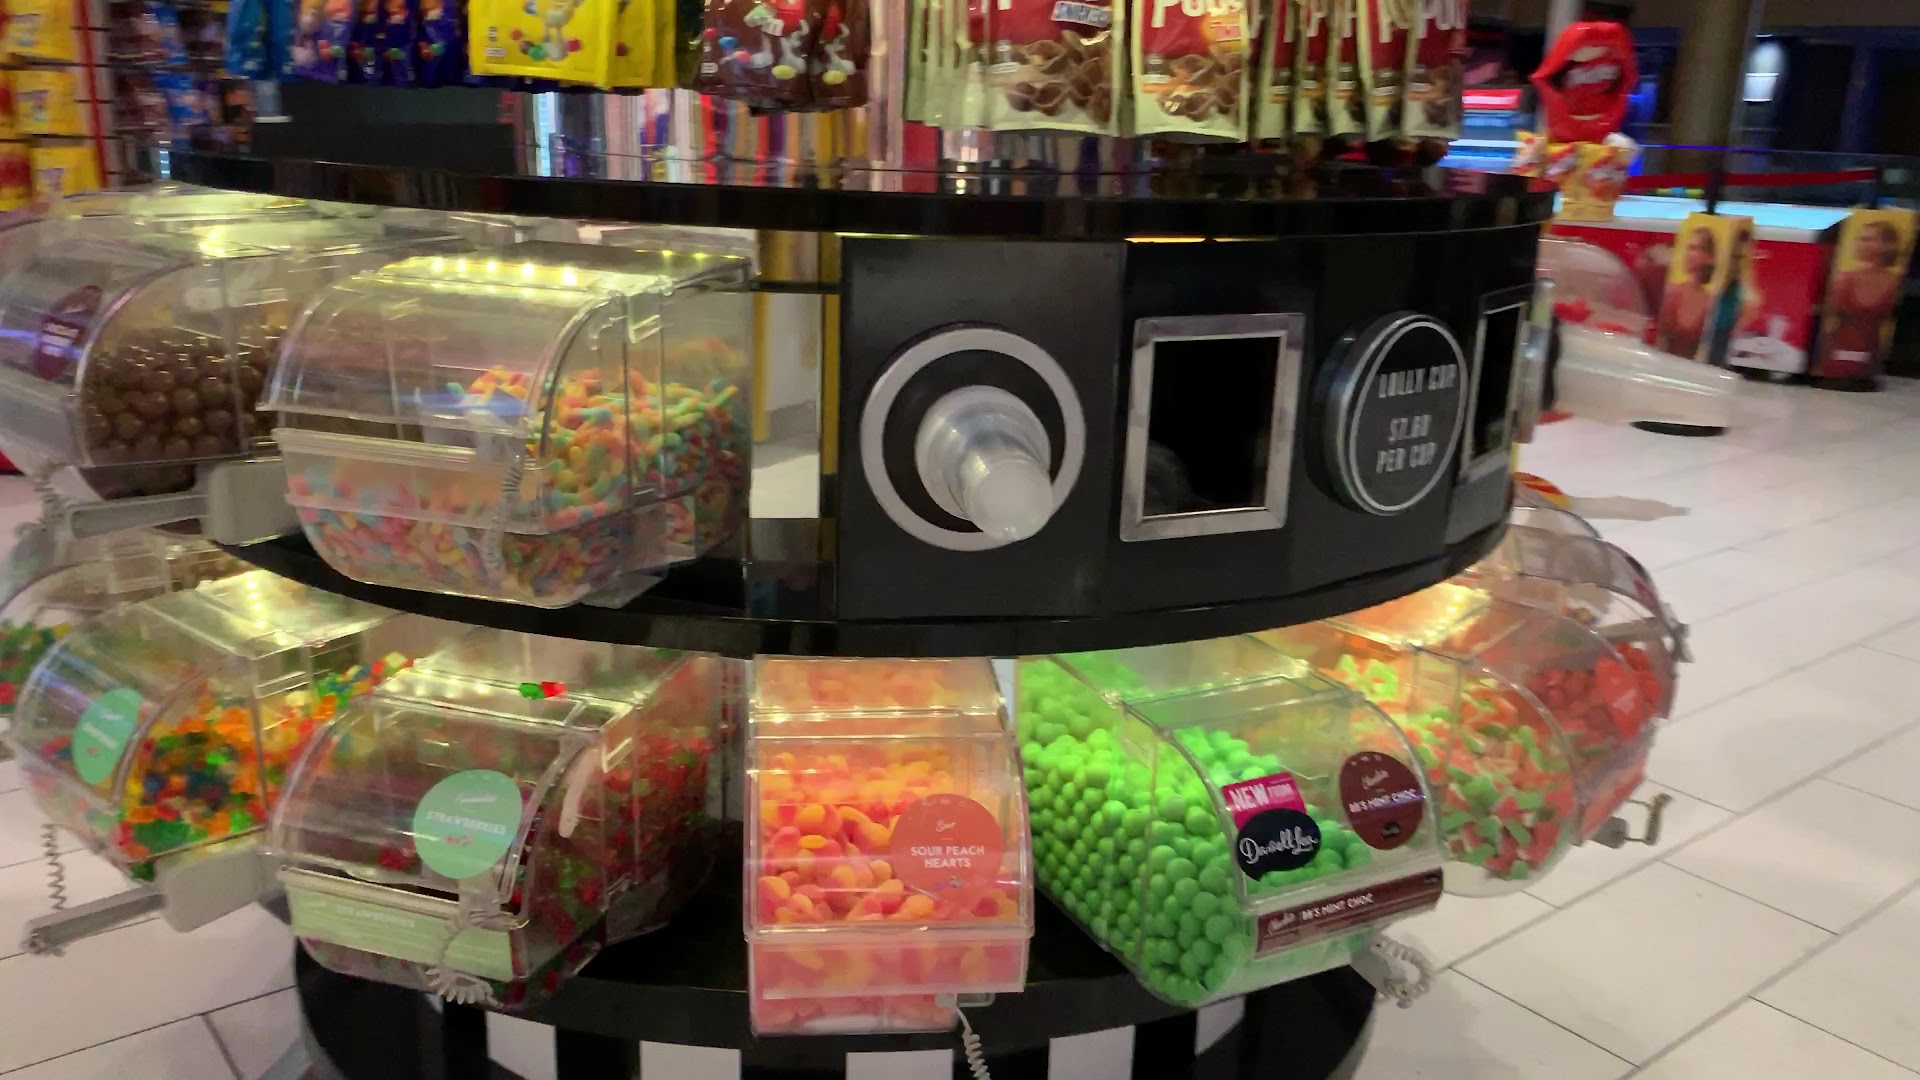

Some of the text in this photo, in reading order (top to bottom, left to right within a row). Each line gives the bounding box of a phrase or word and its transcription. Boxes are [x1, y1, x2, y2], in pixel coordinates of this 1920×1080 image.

[1428, 363, 1457, 390] CUP
[1229, 783, 1270, 811] NEW
[910, 845, 985, 857] SOUR PEACH
[924, 857, 972, 869] HEARTS
